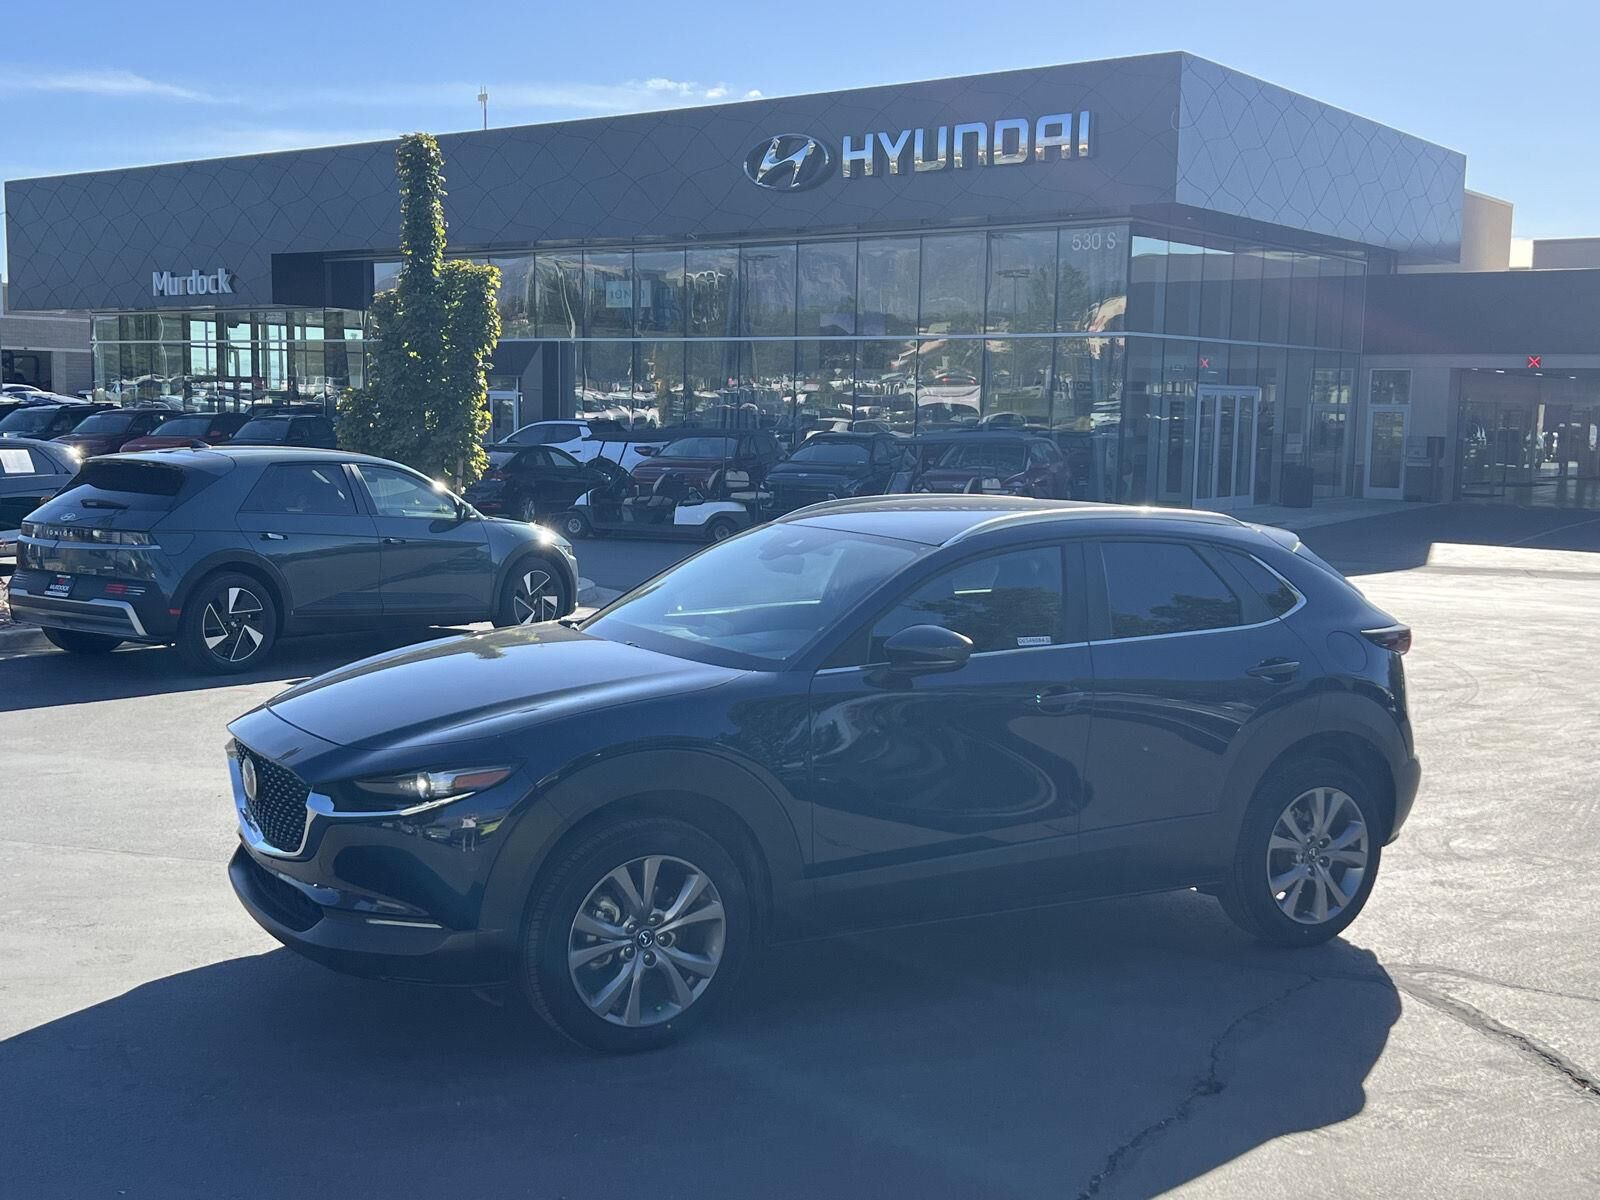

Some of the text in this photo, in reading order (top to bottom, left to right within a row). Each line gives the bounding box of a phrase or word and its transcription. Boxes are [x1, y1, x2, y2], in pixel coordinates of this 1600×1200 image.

[842, 111, 1090, 178] HYUNDAI
[1072, 231, 1116, 251] 530 S
[152, 268, 233, 296] Murdock
